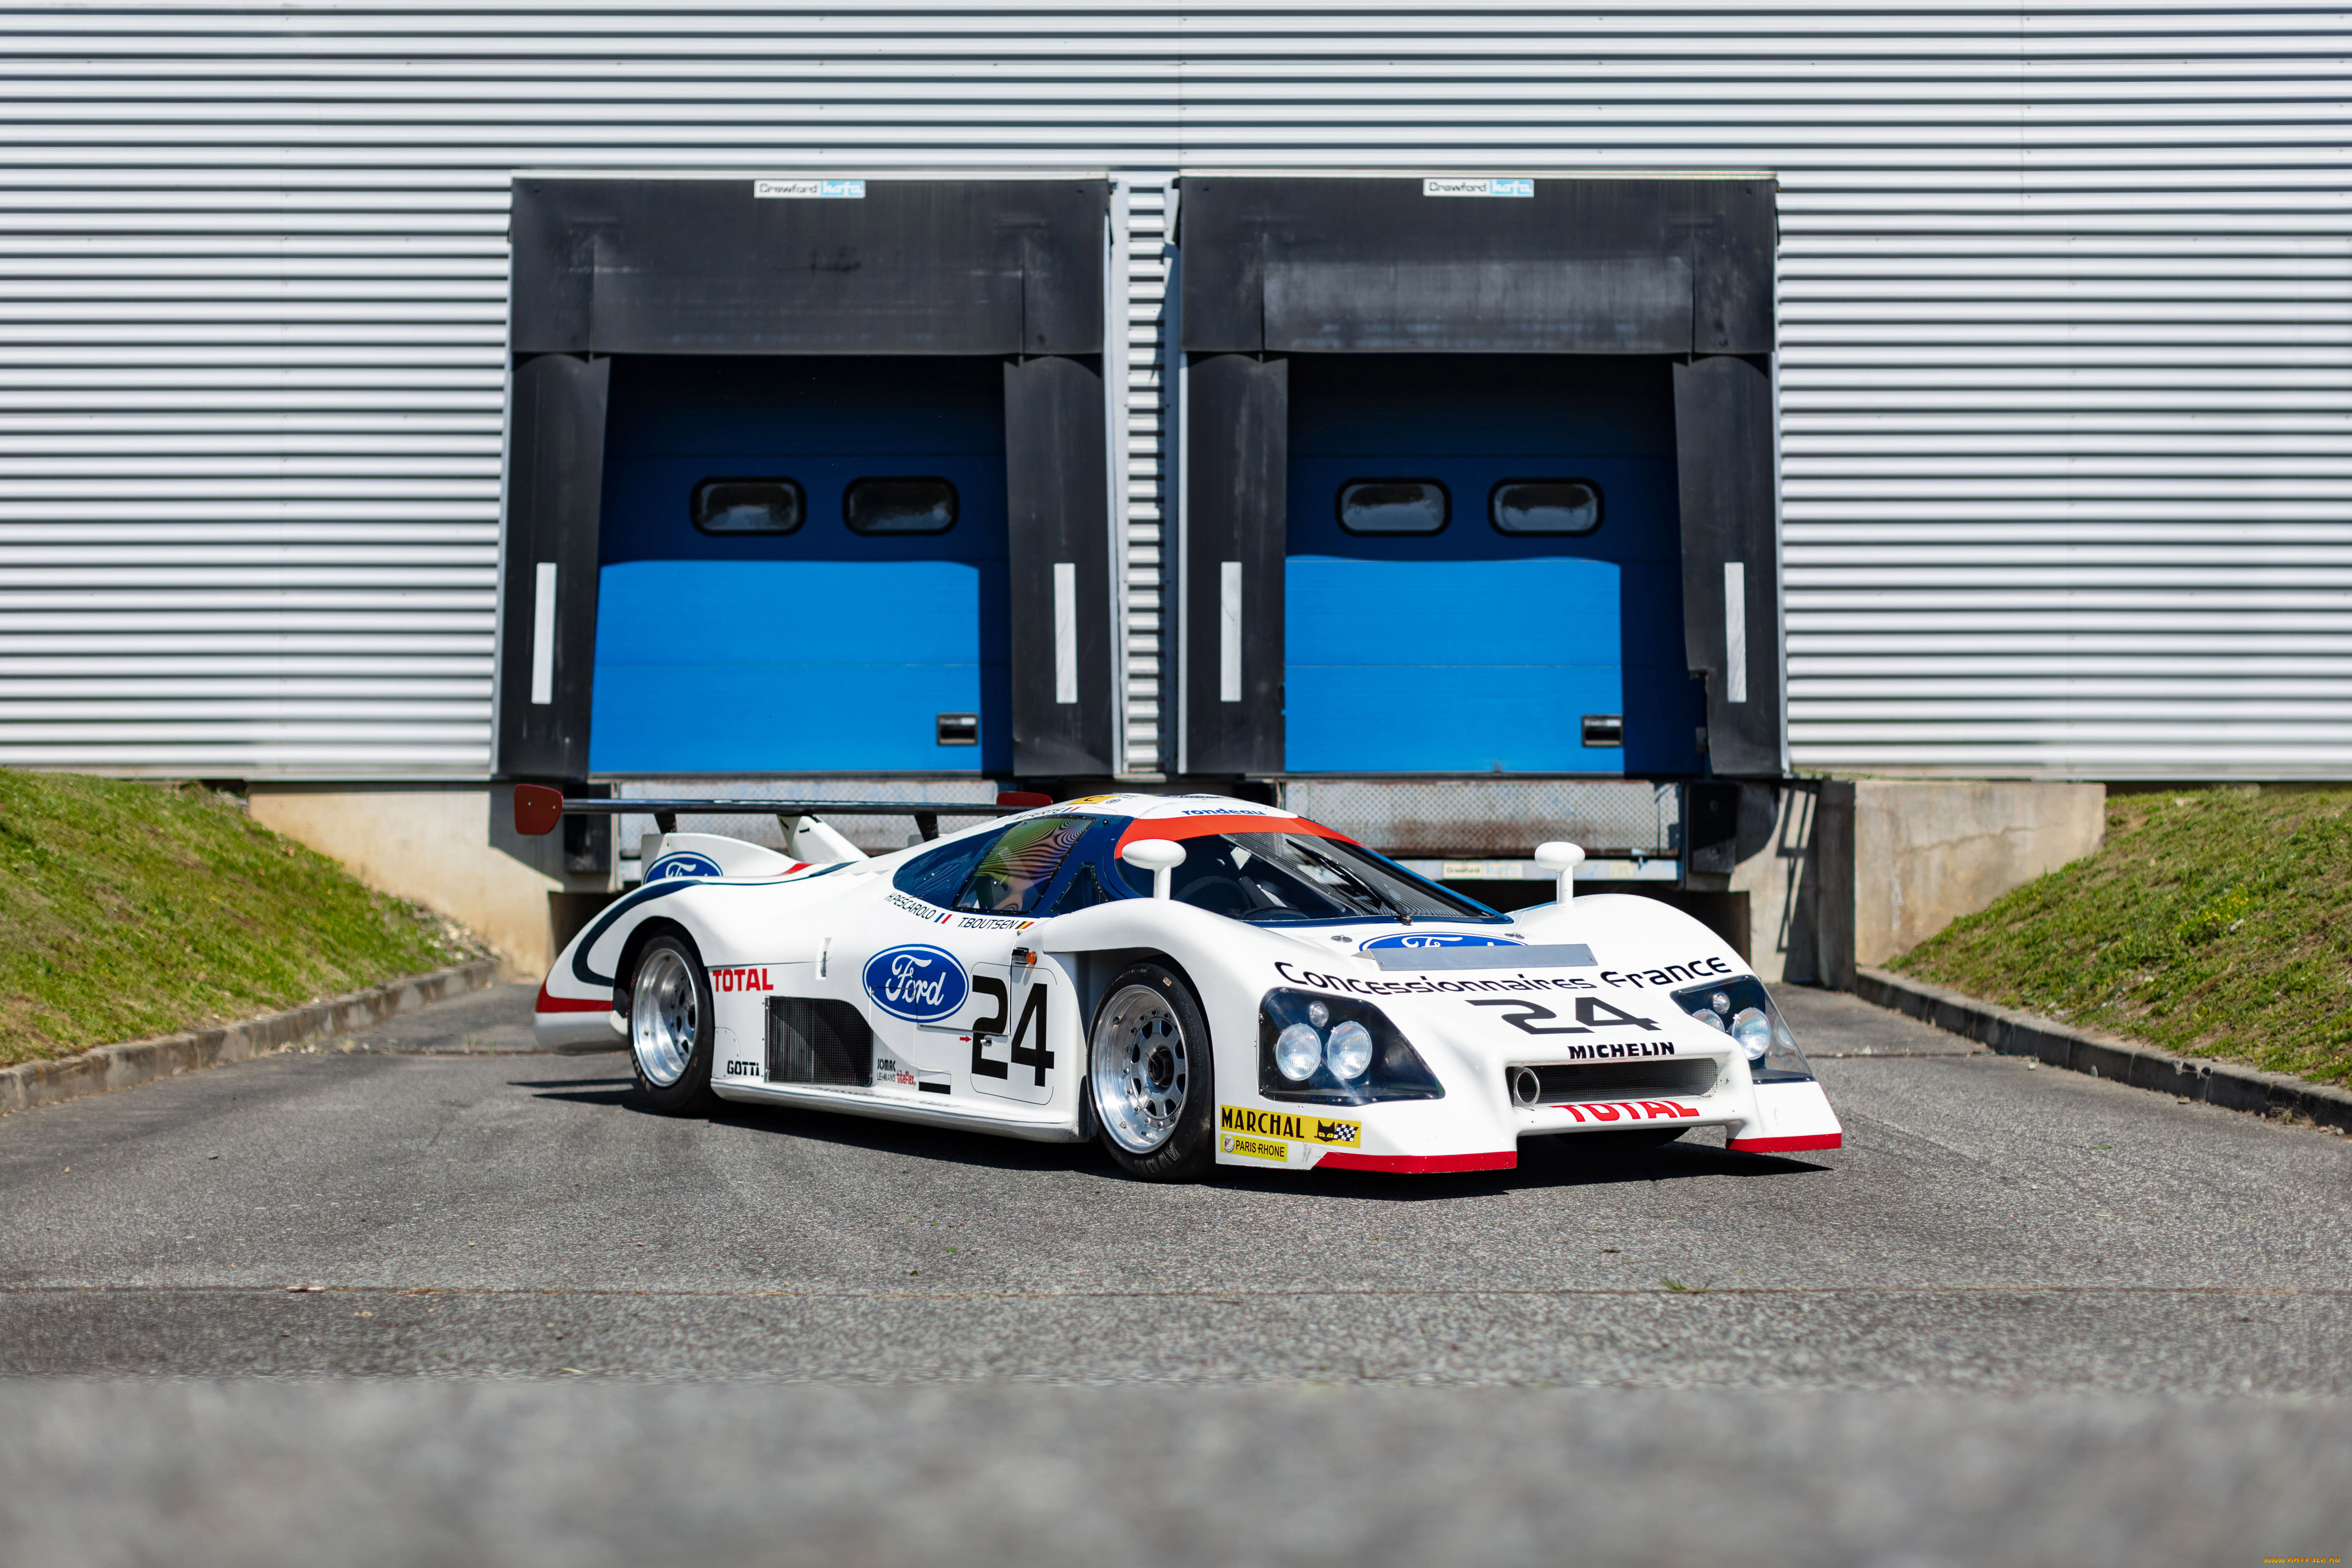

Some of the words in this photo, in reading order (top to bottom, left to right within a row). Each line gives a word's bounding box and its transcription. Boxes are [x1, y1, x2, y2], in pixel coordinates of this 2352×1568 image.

[759, 183, 817, 193] Crawford
[1429, 182, 1486, 192] Crawford
[957, 917, 1020, 930] T.BOUTSEN
[712, 968, 774, 992] TOTAL
[884, 954, 947, 1006] Ford
[1274, 961, 1598, 995] Concessionnaires
[1600, 957, 1733, 988] France
[1464, 997, 1662, 1035] 24
[971, 974, 1055, 1087] 24
[1567, 1042, 1675, 1059] MICHELIN
[877, 1058, 896, 1072] SOMAC
[1221, 1106, 1305, 1139] MARCHAL
[1549, 1101, 1700, 1122] TOTAL
